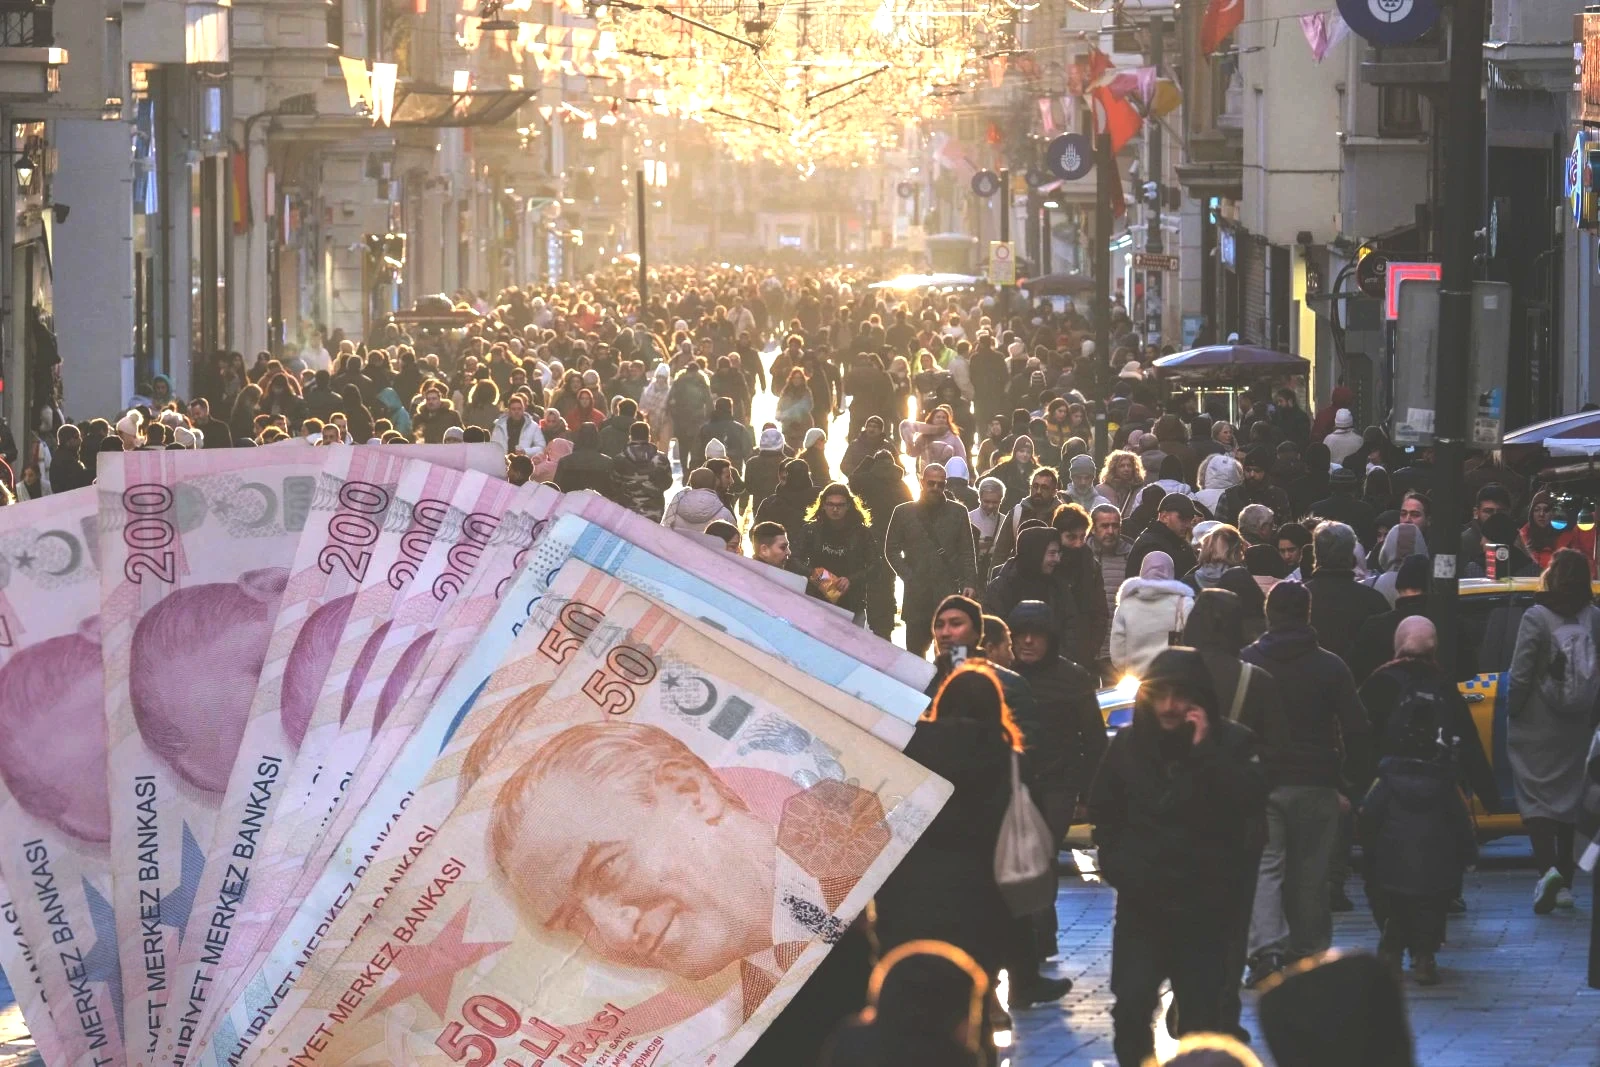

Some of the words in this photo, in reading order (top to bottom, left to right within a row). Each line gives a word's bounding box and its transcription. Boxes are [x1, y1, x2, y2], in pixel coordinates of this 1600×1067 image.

[122, 483, 175, 585] 200
[318, 481, 389, 583] 200
[538, 602, 606, 665] 50
[582, 645, 658, 715] 50
[135, 775, 160, 881] BANKASI
[201, 864, 249, 965] MERKEZ
[233, 755, 283, 860] BANKASI
[23, 838, 75, 944] BANKASI
[139, 887, 168, 992] MERKEZ
[59, 947, 109, 1050] MERKEZ
[287, 1022, 335, 1067] İYET
[329, 942, 402, 1024] MERKEZ
[393, 857, 467, 943] BANKASI
[434, 994, 522, 1067] 50
